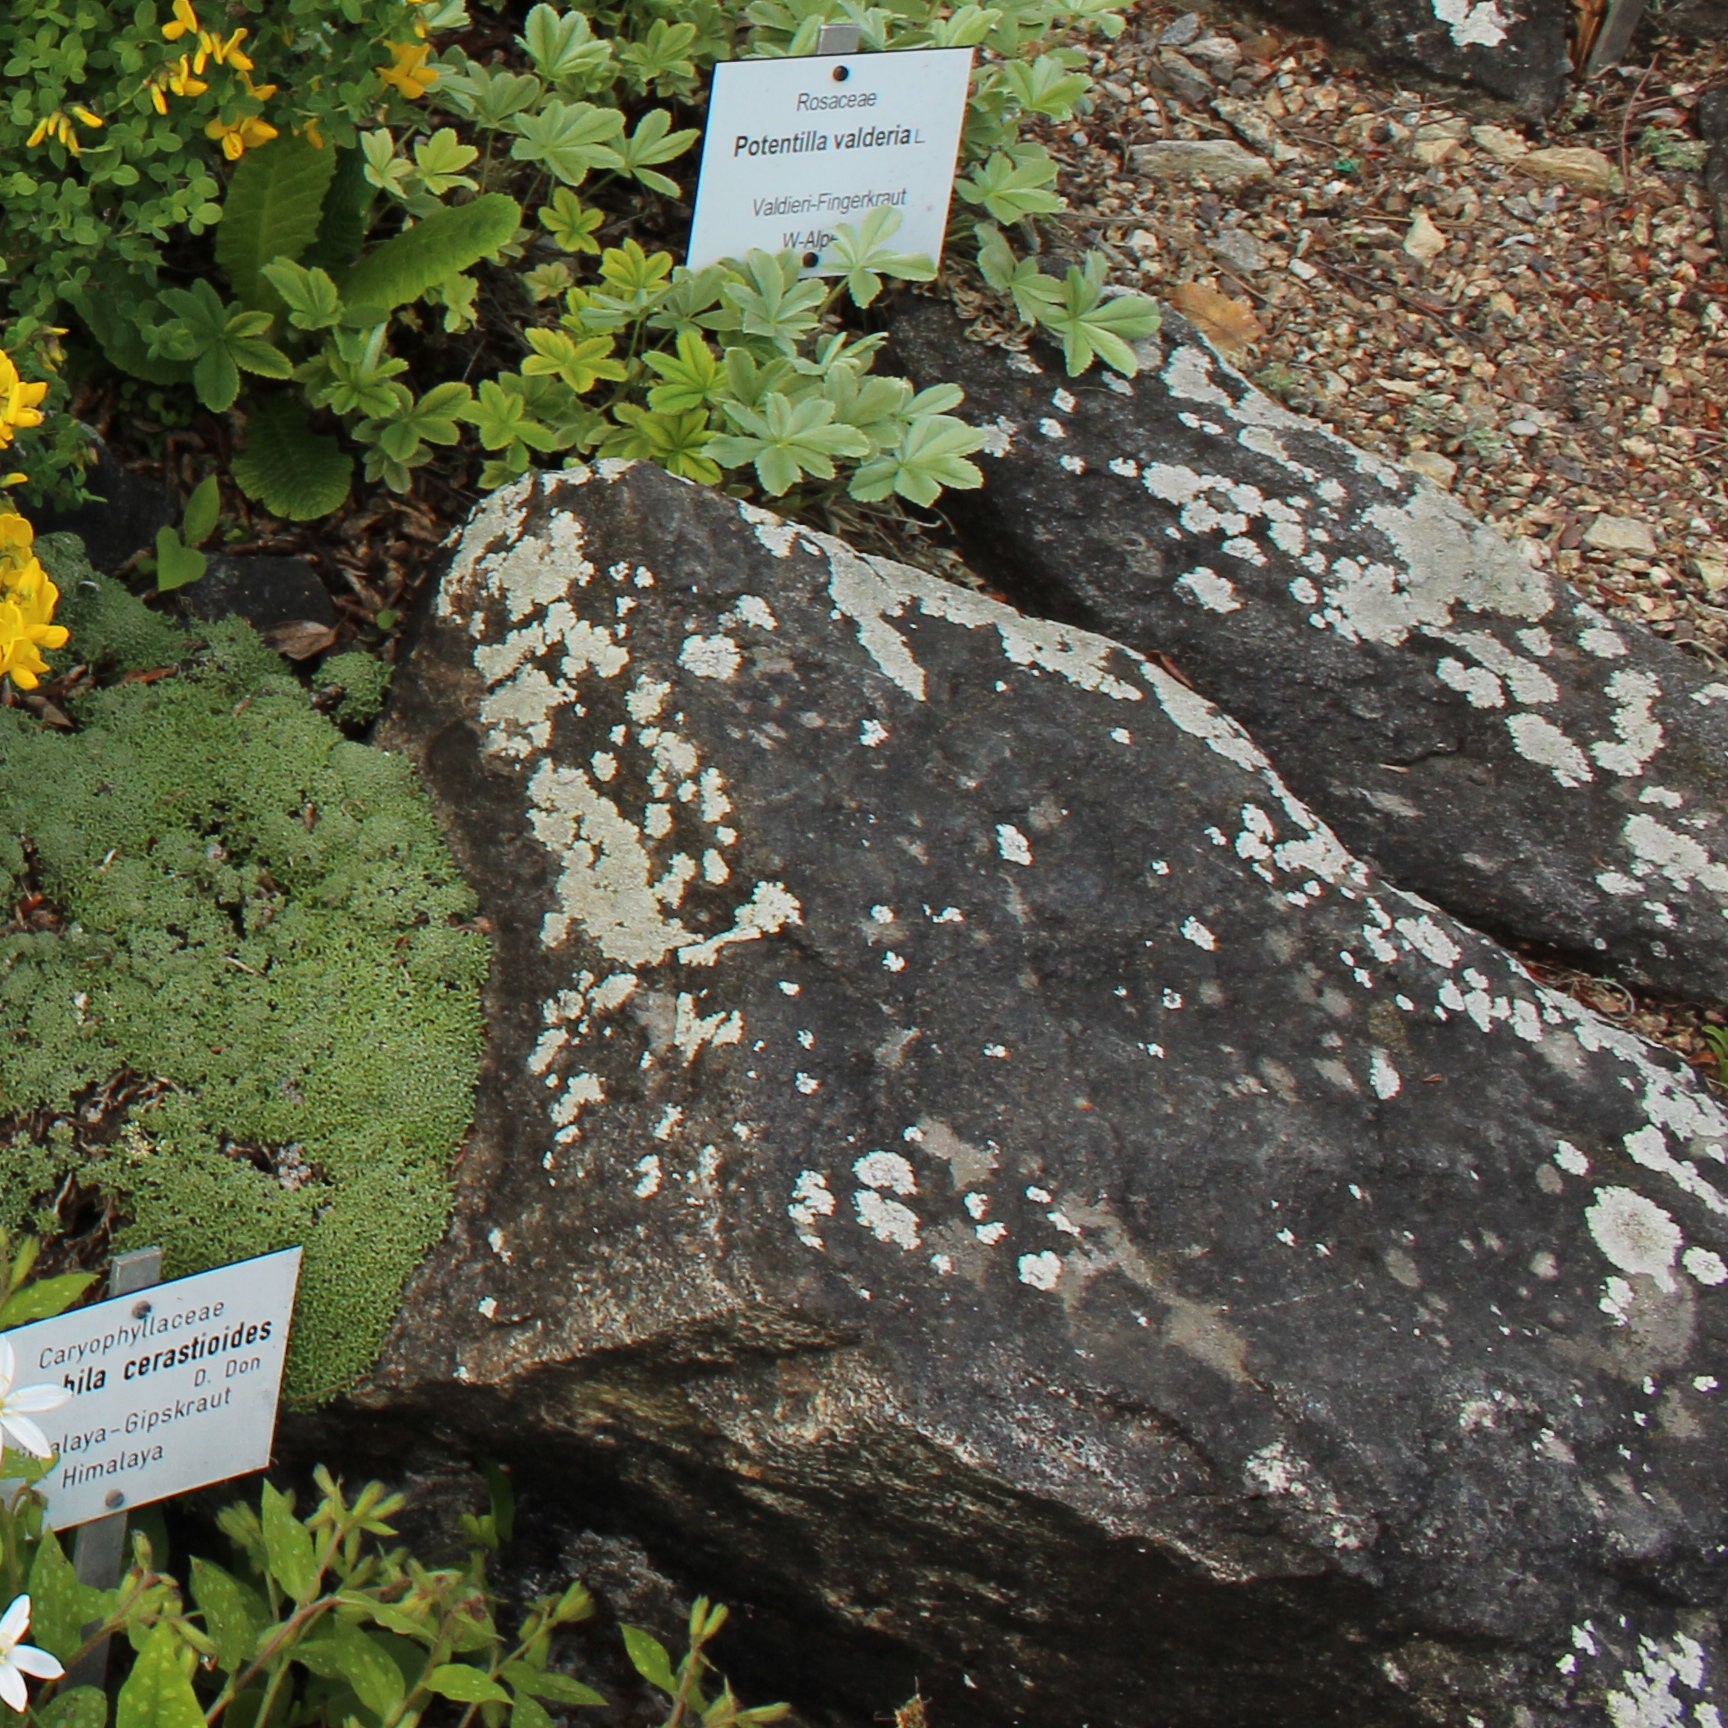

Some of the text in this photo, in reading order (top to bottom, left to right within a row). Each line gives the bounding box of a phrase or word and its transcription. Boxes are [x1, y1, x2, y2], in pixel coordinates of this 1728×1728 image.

[796, 92, 877, 111] Rosaceae
[734, 129, 828, 157] Potentilla
[833, 123, 912, 150] valderia
[38, 1300, 225, 1370] Caryophyllaceae
[123, 1317, 272, 1381] cerastioides
[225, 1356, 261, 1379] Don
[47, 1386, 232, 1456] alaya-Gipskraut
[61, 1443, 164, 1489] Himalaya
